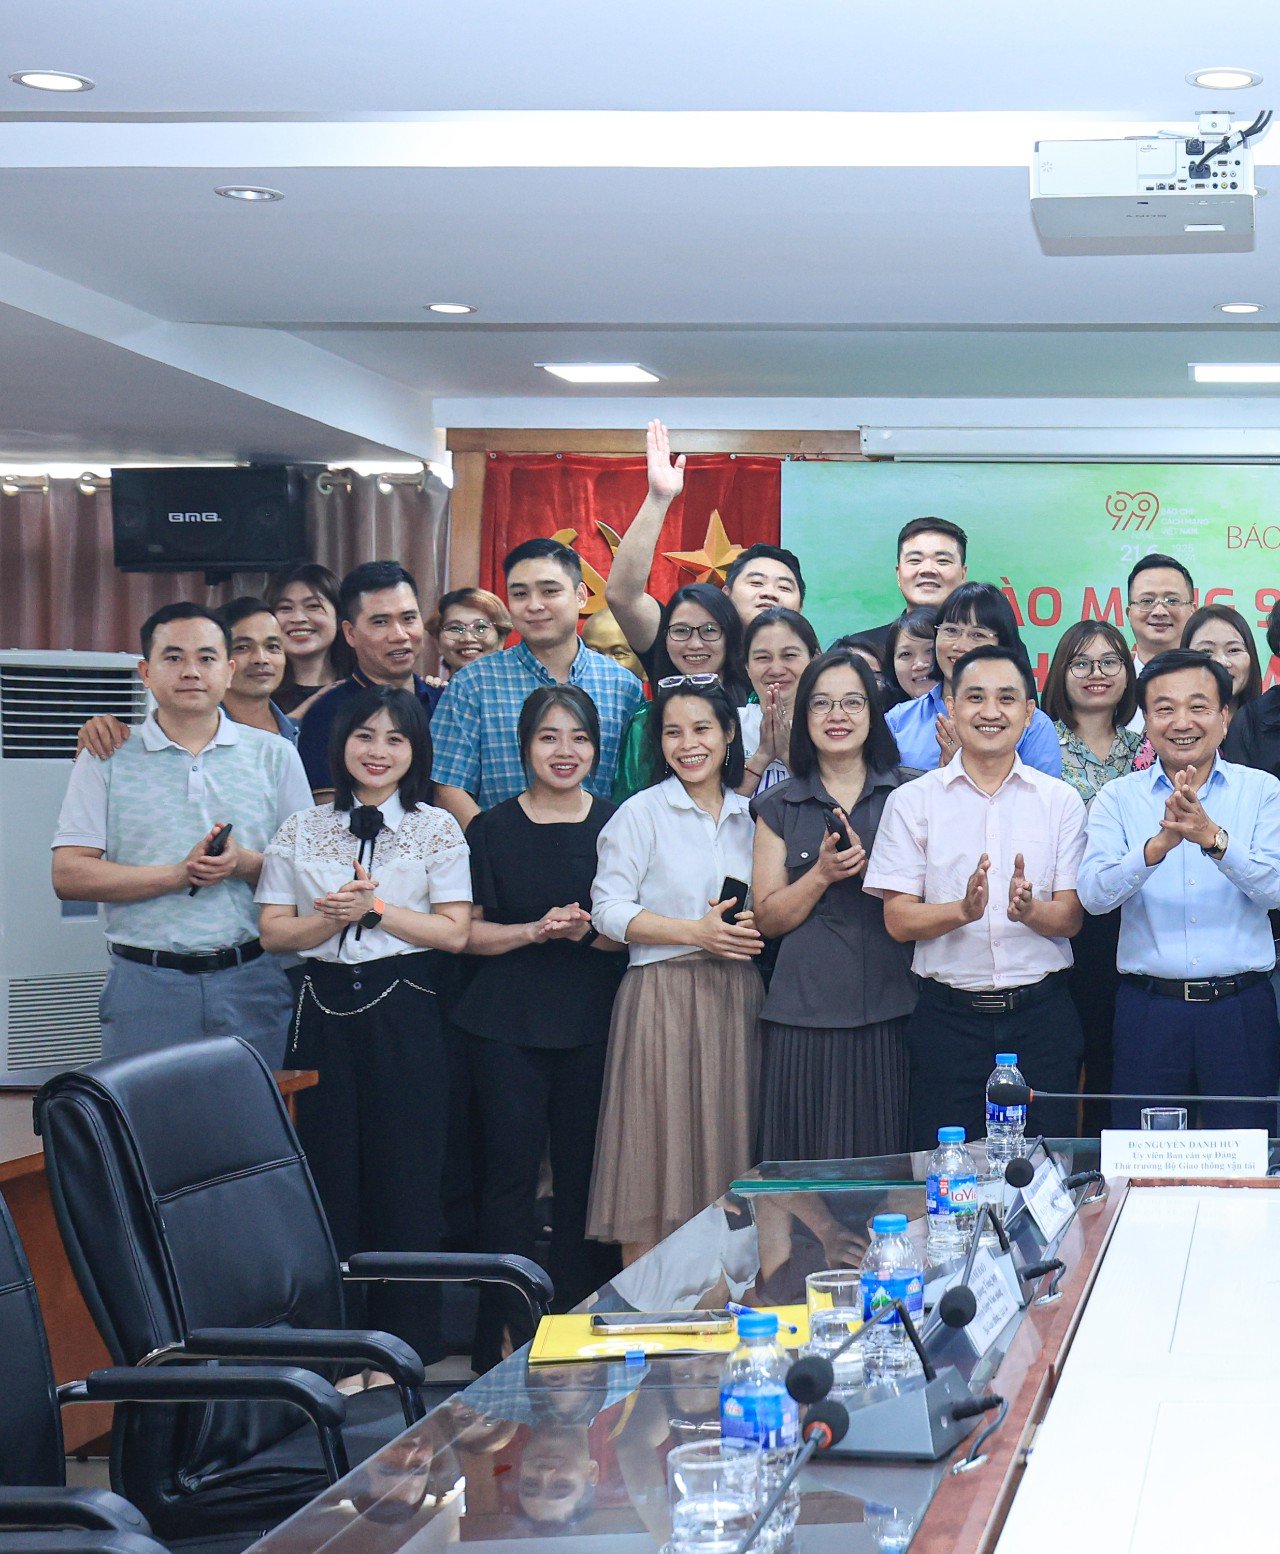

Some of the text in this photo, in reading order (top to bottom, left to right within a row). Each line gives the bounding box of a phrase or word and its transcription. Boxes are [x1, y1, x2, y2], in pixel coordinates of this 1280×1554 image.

[1189, 1141, 1217, 1149] DANH
[1220, 1141, 1240, 1149] HUY
[1179, 1162, 1199, 1170] Giao
